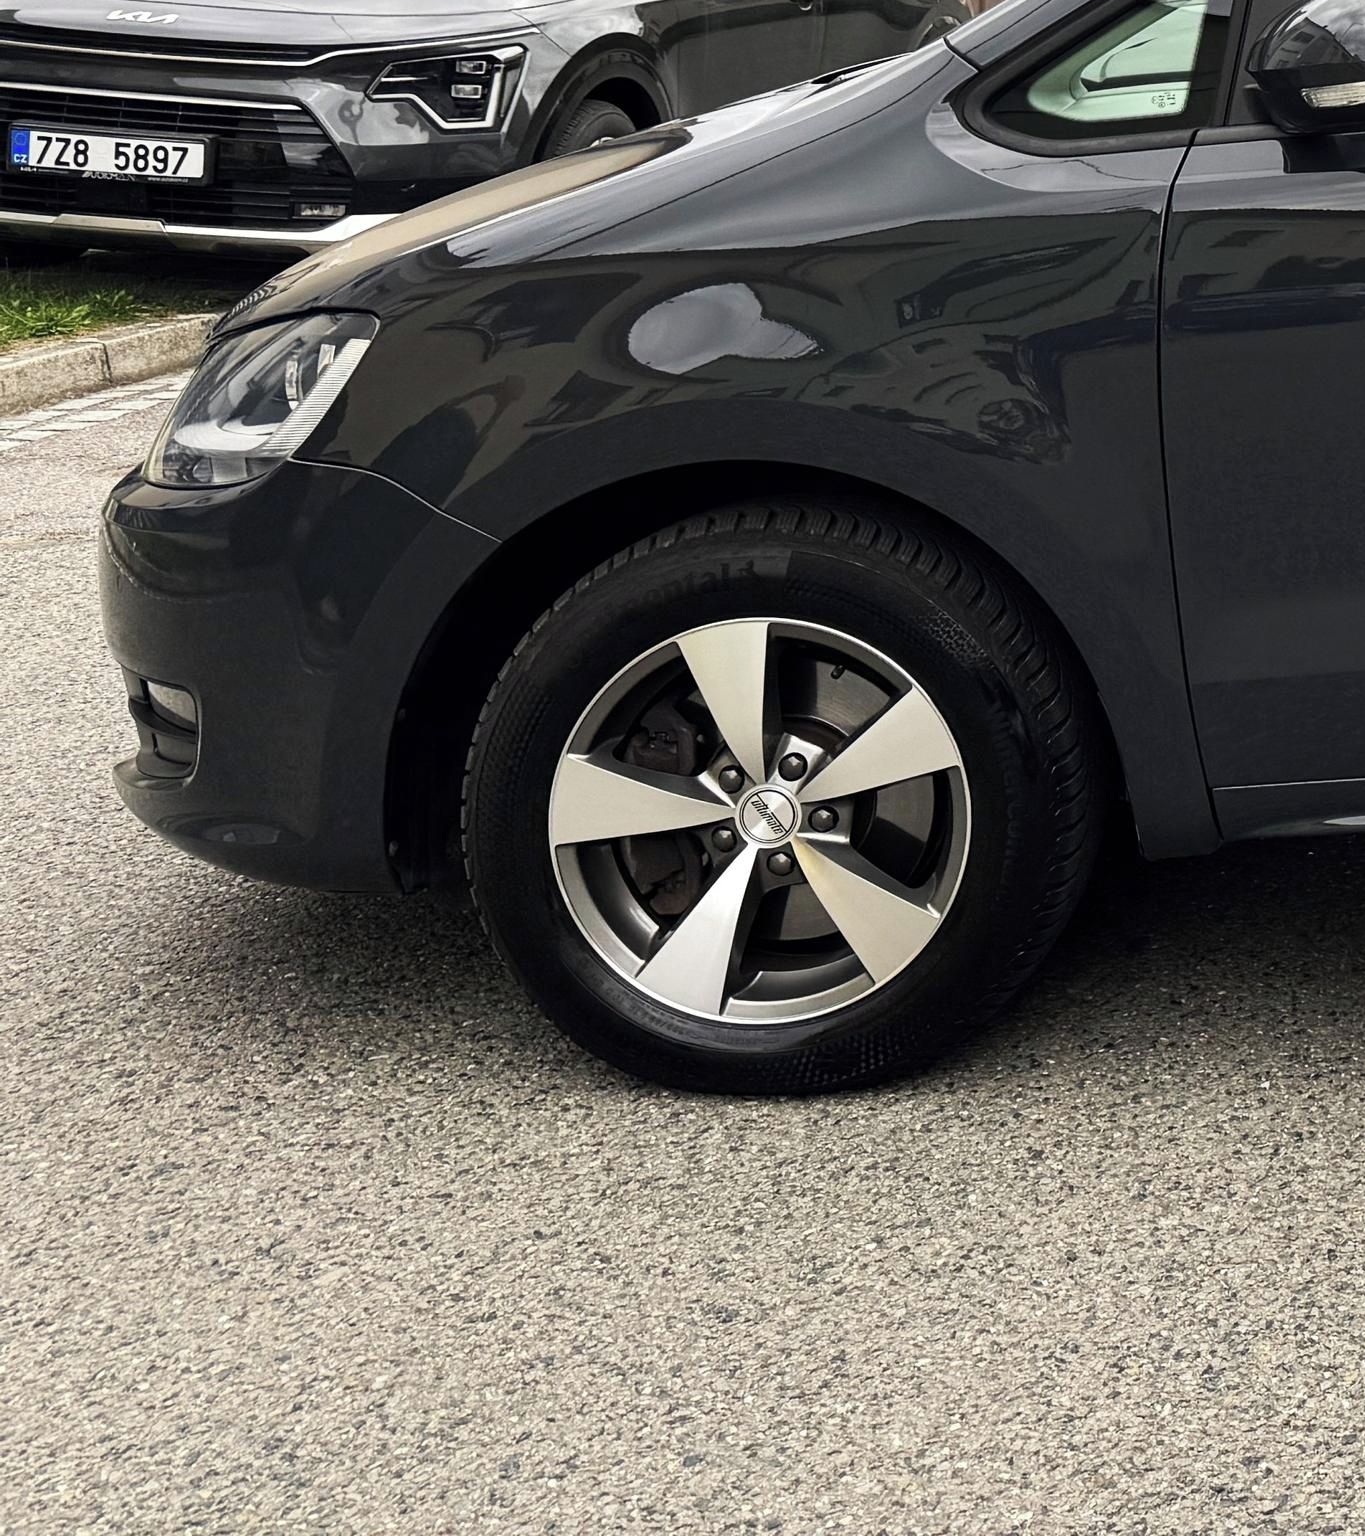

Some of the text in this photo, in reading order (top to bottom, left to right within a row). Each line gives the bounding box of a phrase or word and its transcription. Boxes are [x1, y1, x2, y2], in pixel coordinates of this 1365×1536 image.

[14, 154, 28, 164] CZ
[36, 135, 189, 176] 7Z8 5897
[750, 799, 784, 835] ultimate
